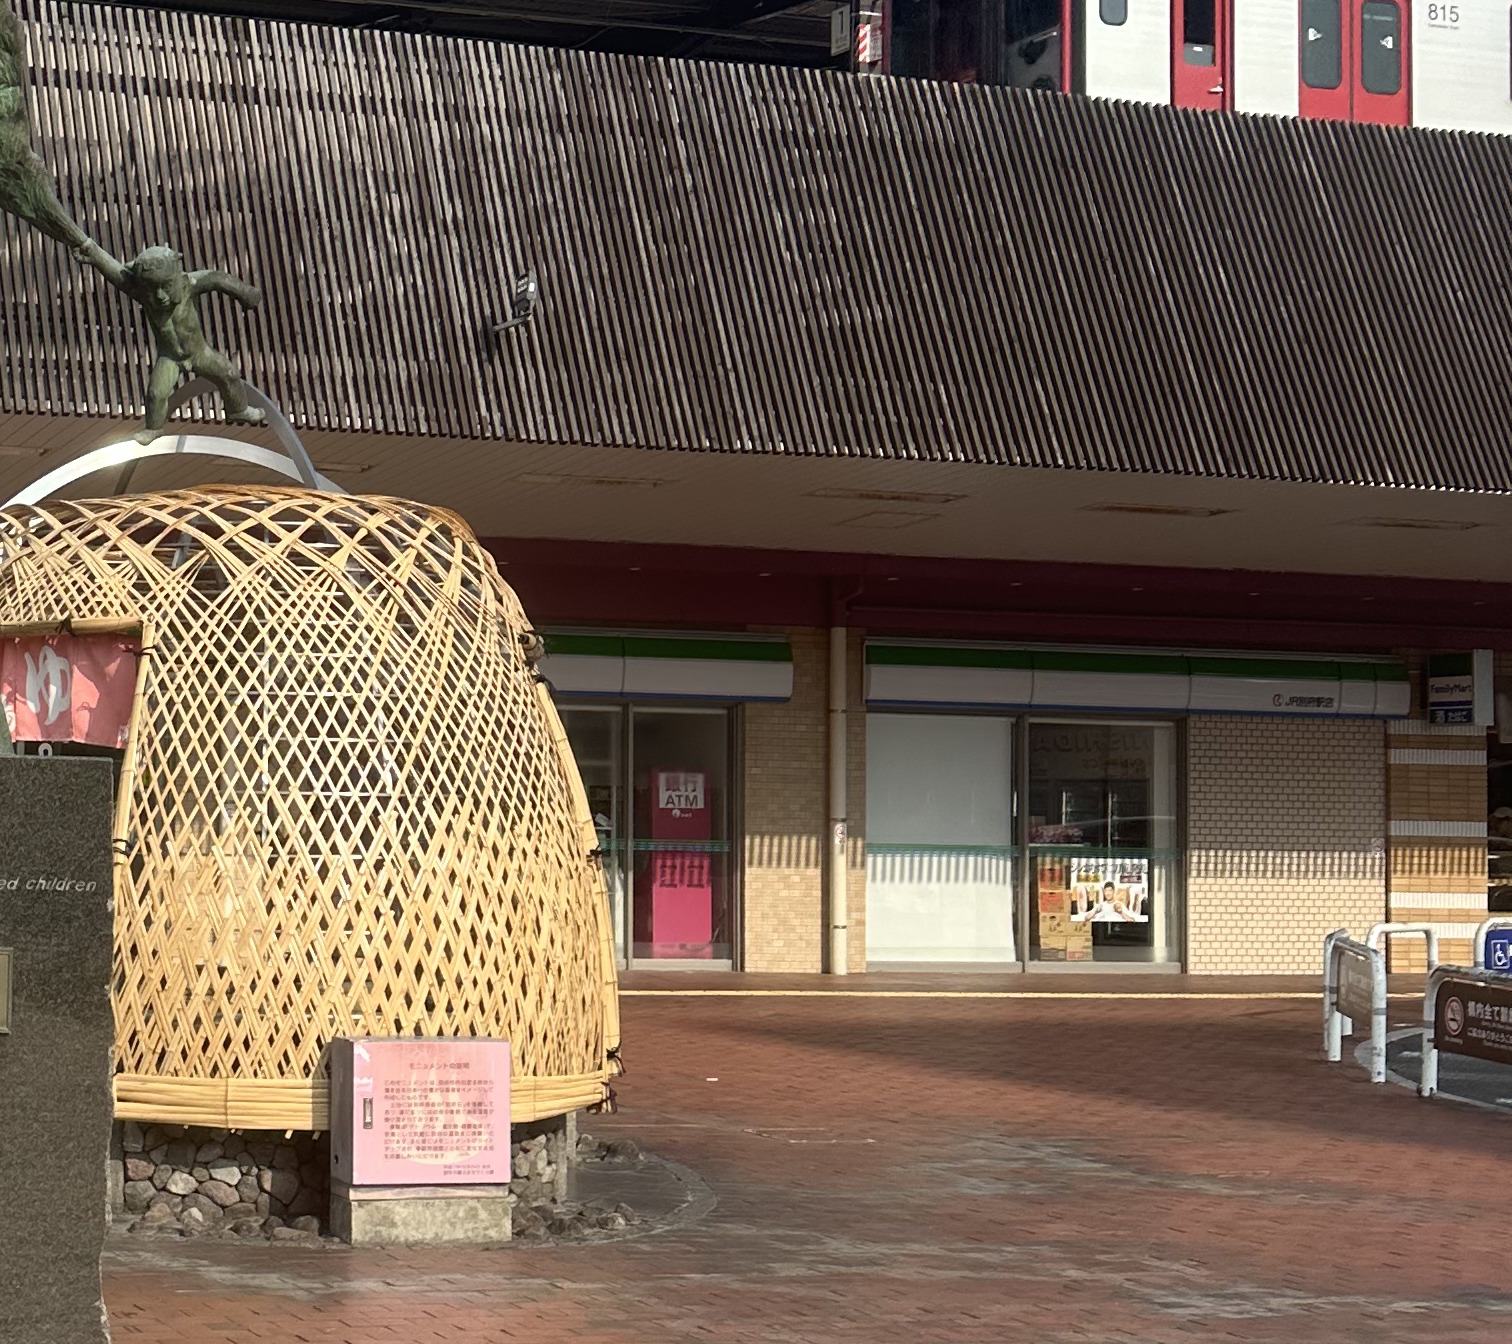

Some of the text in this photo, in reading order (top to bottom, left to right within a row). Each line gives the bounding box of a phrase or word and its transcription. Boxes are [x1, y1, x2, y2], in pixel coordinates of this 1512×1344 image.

[1428, 3, 1459, 23] 815
[24, 644, 71, 726] ゆ
[665, 795, 699, 808] ATM
[25, 876, 97, 892] children
